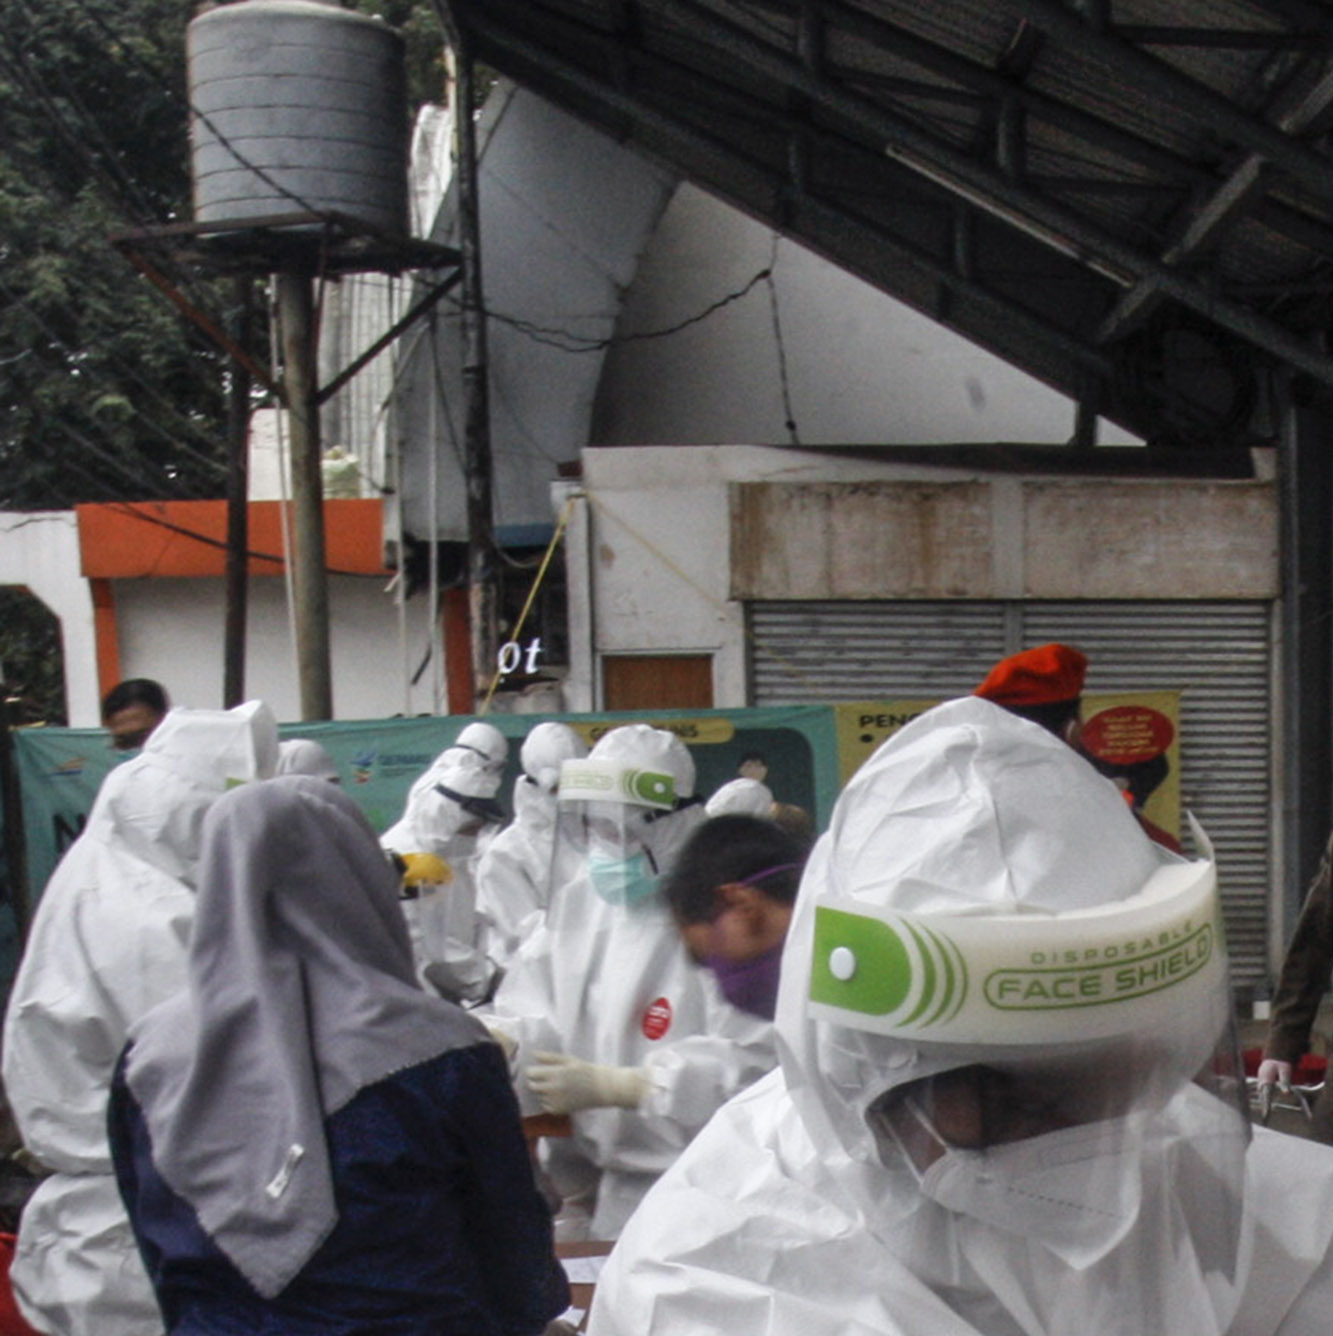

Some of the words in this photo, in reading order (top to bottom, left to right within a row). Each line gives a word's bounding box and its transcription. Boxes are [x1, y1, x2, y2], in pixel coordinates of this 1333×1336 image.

[998, 974, 1102, 1000] FACE
[1115, 936, 1209, 992] SHIELD
[1031, 921, 1192, 965] DISPOSABLE
